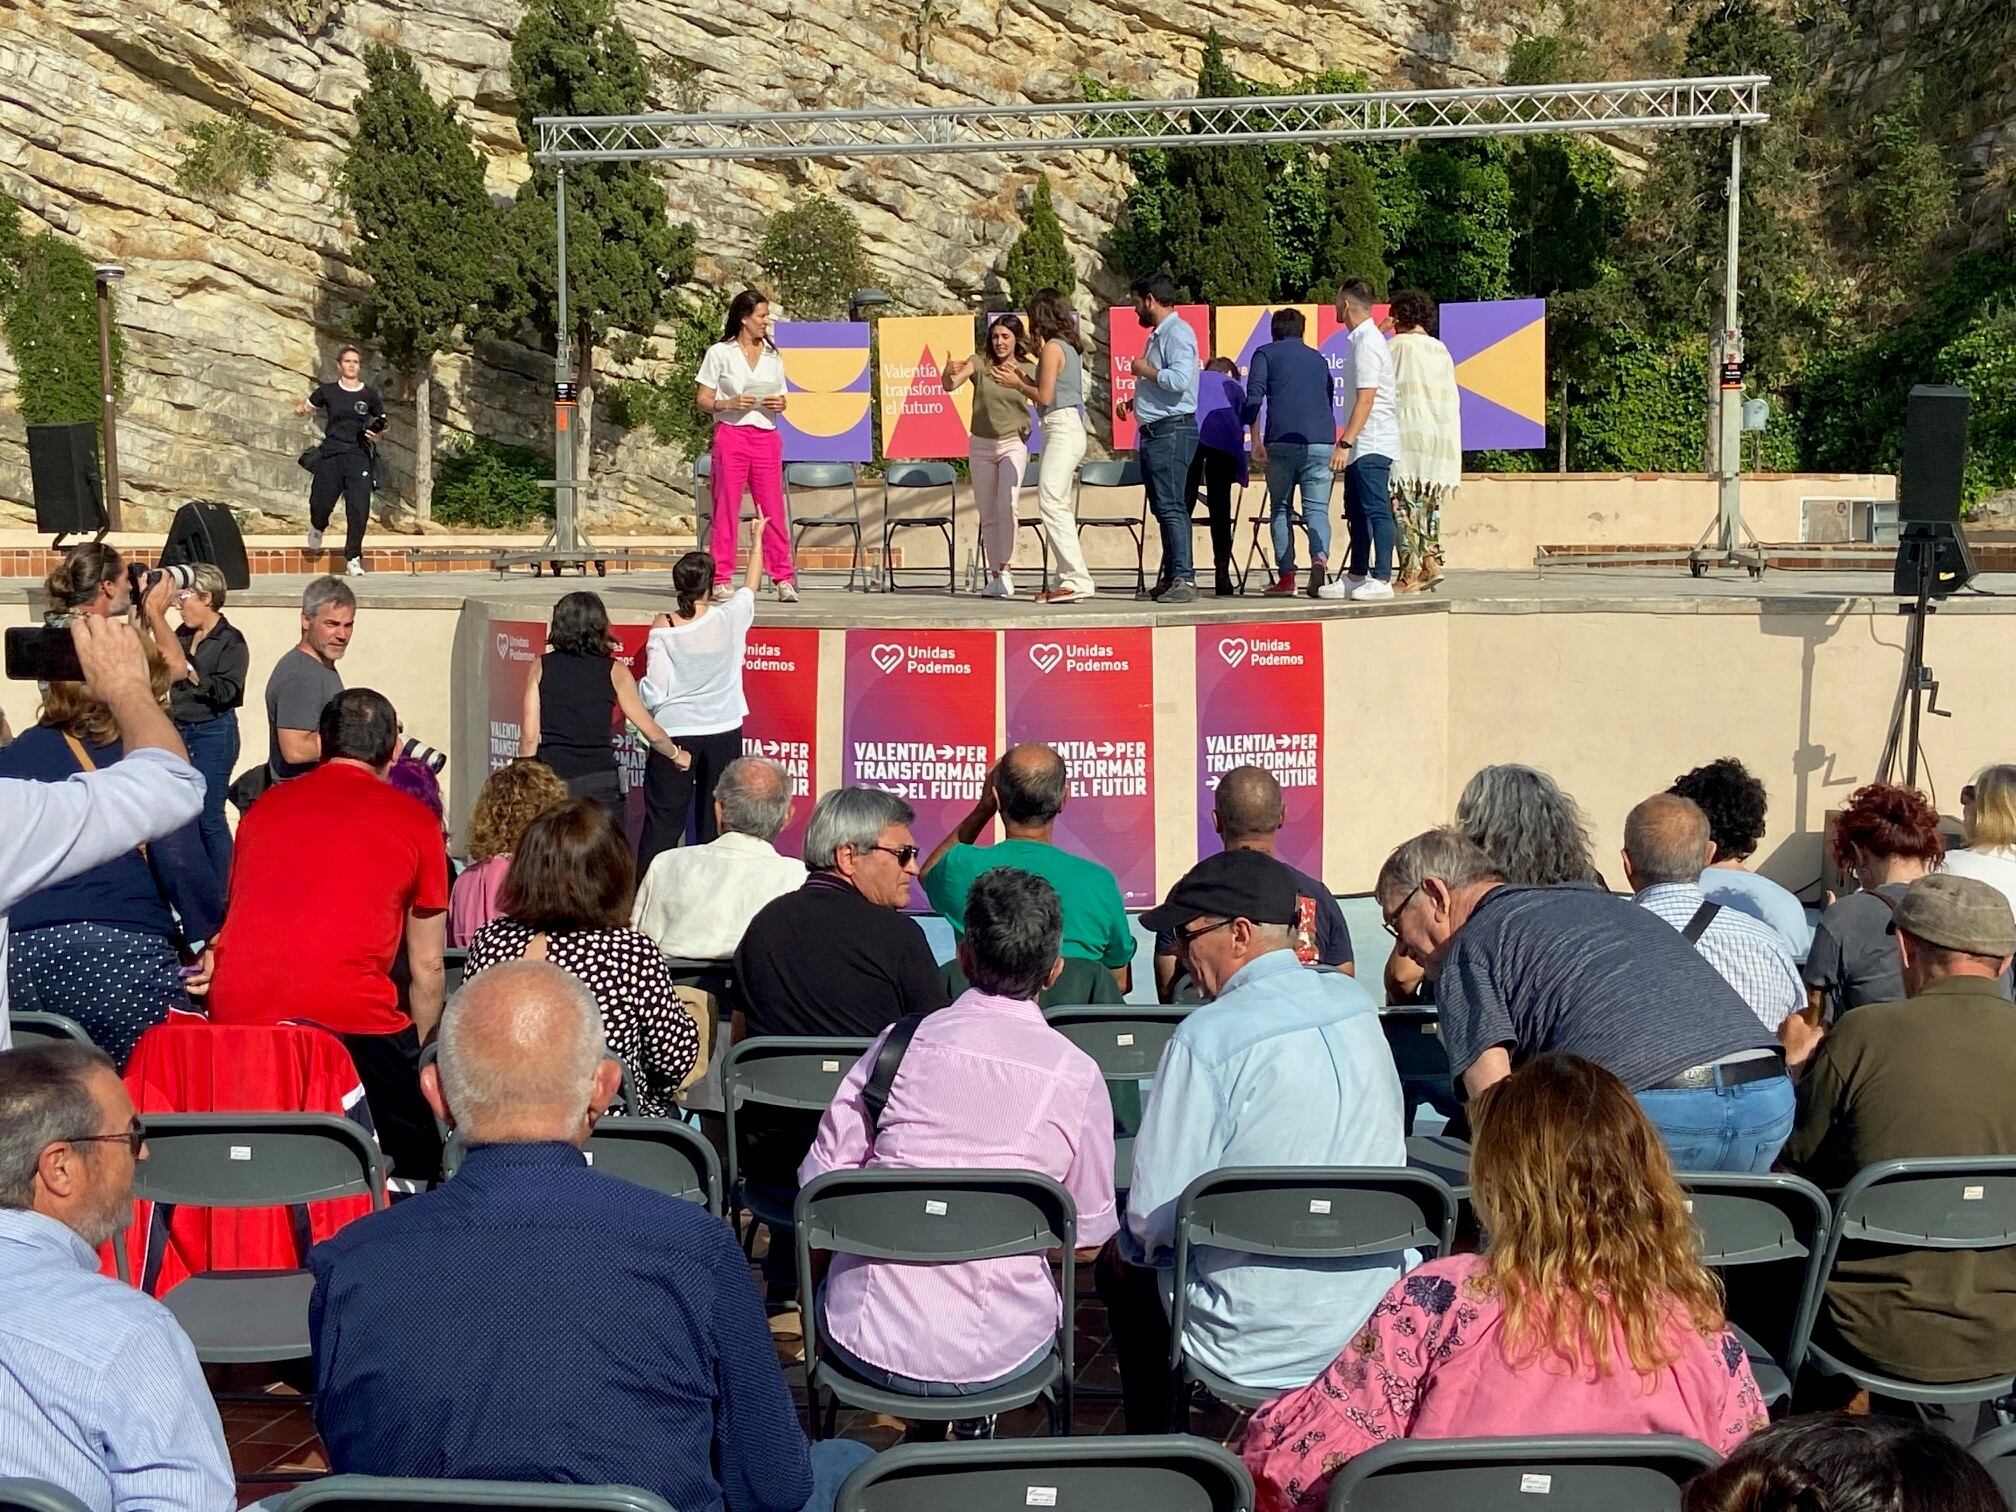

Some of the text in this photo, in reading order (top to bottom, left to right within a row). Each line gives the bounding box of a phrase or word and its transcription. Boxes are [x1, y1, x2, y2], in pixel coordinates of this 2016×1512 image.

[884, 363, 937, 378] Valentía
[886, 400, 943, 415] el futuro
[747, 643, 781, 656] nidas
[907, 646, 956, 659] Unidas
[1066, 644, 1114, 657] Unidas
[1250, 639, 1291, 652] Unidas
[907, 661, 972, 674] Podemos
[1066, 659, 1130, 672] Podemos
[1250, 654, 1304, 666] Podemos
[491, 721, 521, 740] VALENTIA
[781, 742, 809, 759] PER
[1115, 742, 1146, 758] PER
[1205, 733, 1318, 754] VALENTIA PER
[854, 742, 987, 762] VALENTIA PER
[1064, 758, 1146, 779] SFORMAR
[1205, 750, 1316, 773] TRANSFORMAR
[854, 761, 986, 781] TRANSFORMAR
[908, 783, 927, 799] EL
[1070, 778, 1147, 797] EL FUTUR
